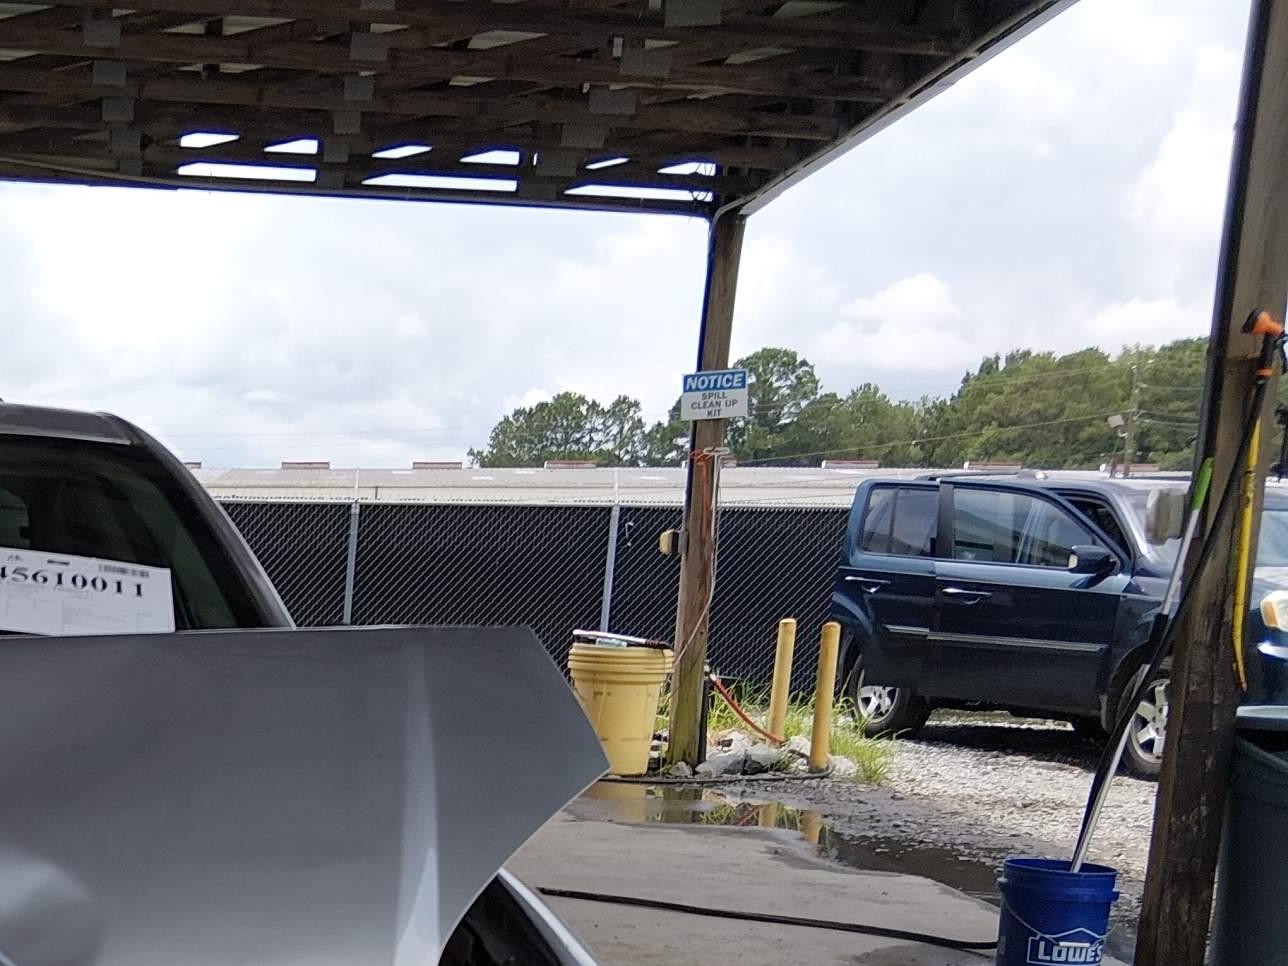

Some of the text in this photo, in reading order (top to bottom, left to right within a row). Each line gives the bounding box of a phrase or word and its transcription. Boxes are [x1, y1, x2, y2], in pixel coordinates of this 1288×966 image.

[686, 373, 744, 391] NOTICE
[702, 392, 727, 400] SPILL
[691, 399, 738, 409] CLEAN UP
[707, 409, 722, 417] KIT
